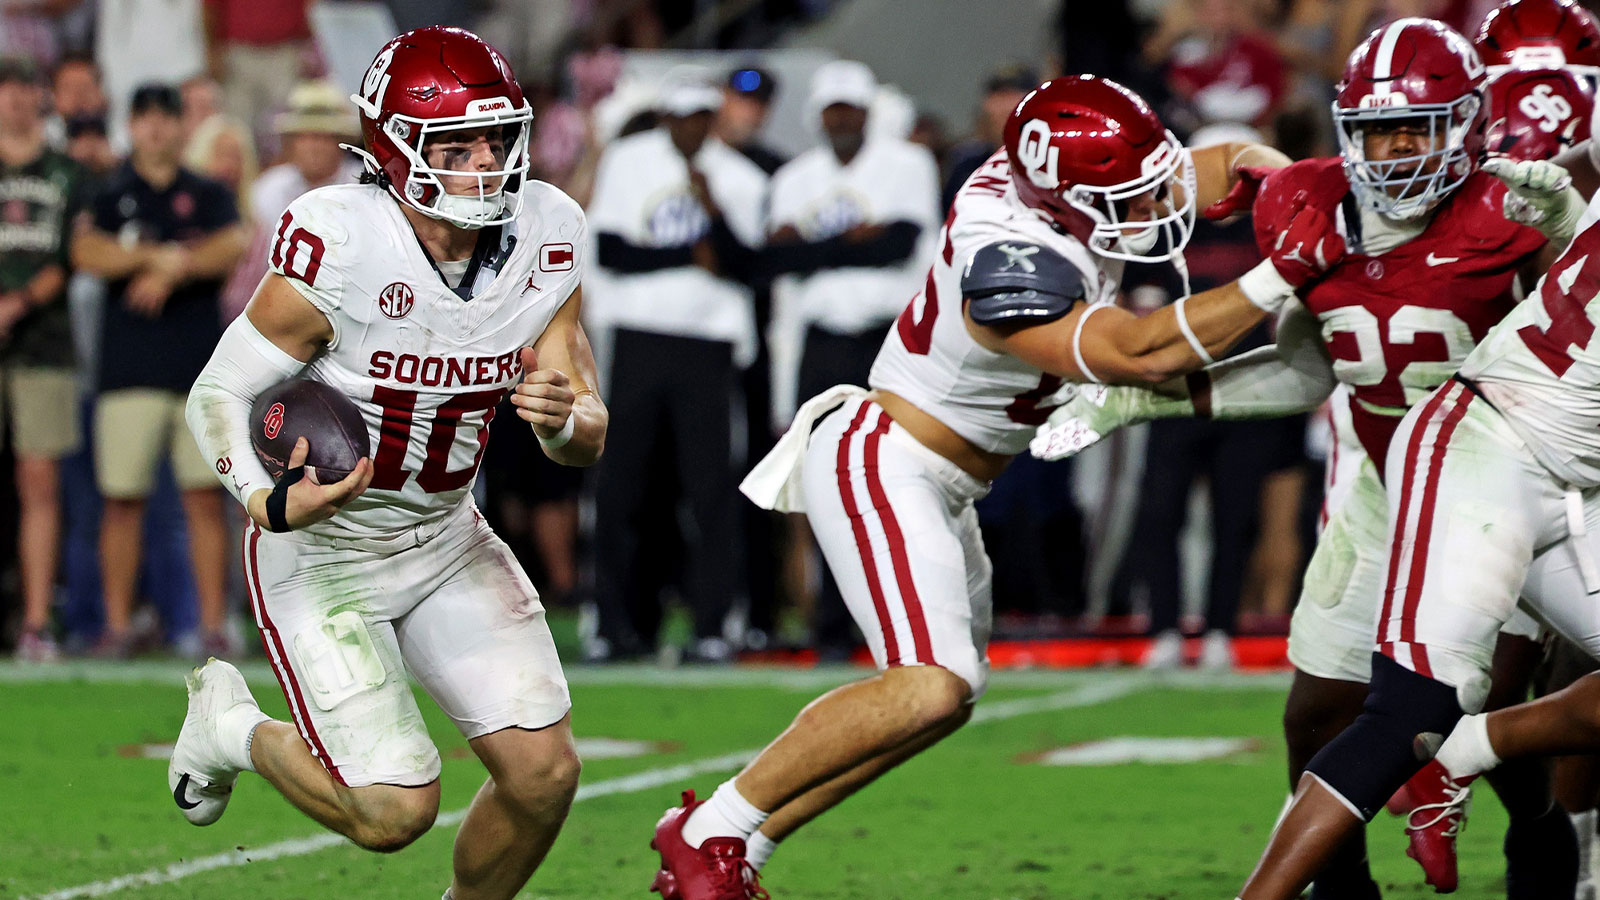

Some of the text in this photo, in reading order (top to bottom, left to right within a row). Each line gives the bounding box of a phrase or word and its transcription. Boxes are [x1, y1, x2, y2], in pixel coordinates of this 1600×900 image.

[1519, 84, 1572, 133] 96
[1018, 118, 1060, 190] OU
[271, 209, 326, 288] 10
[380, 283, 415, 318] SEC
[367, 384, 509, 494] 10
